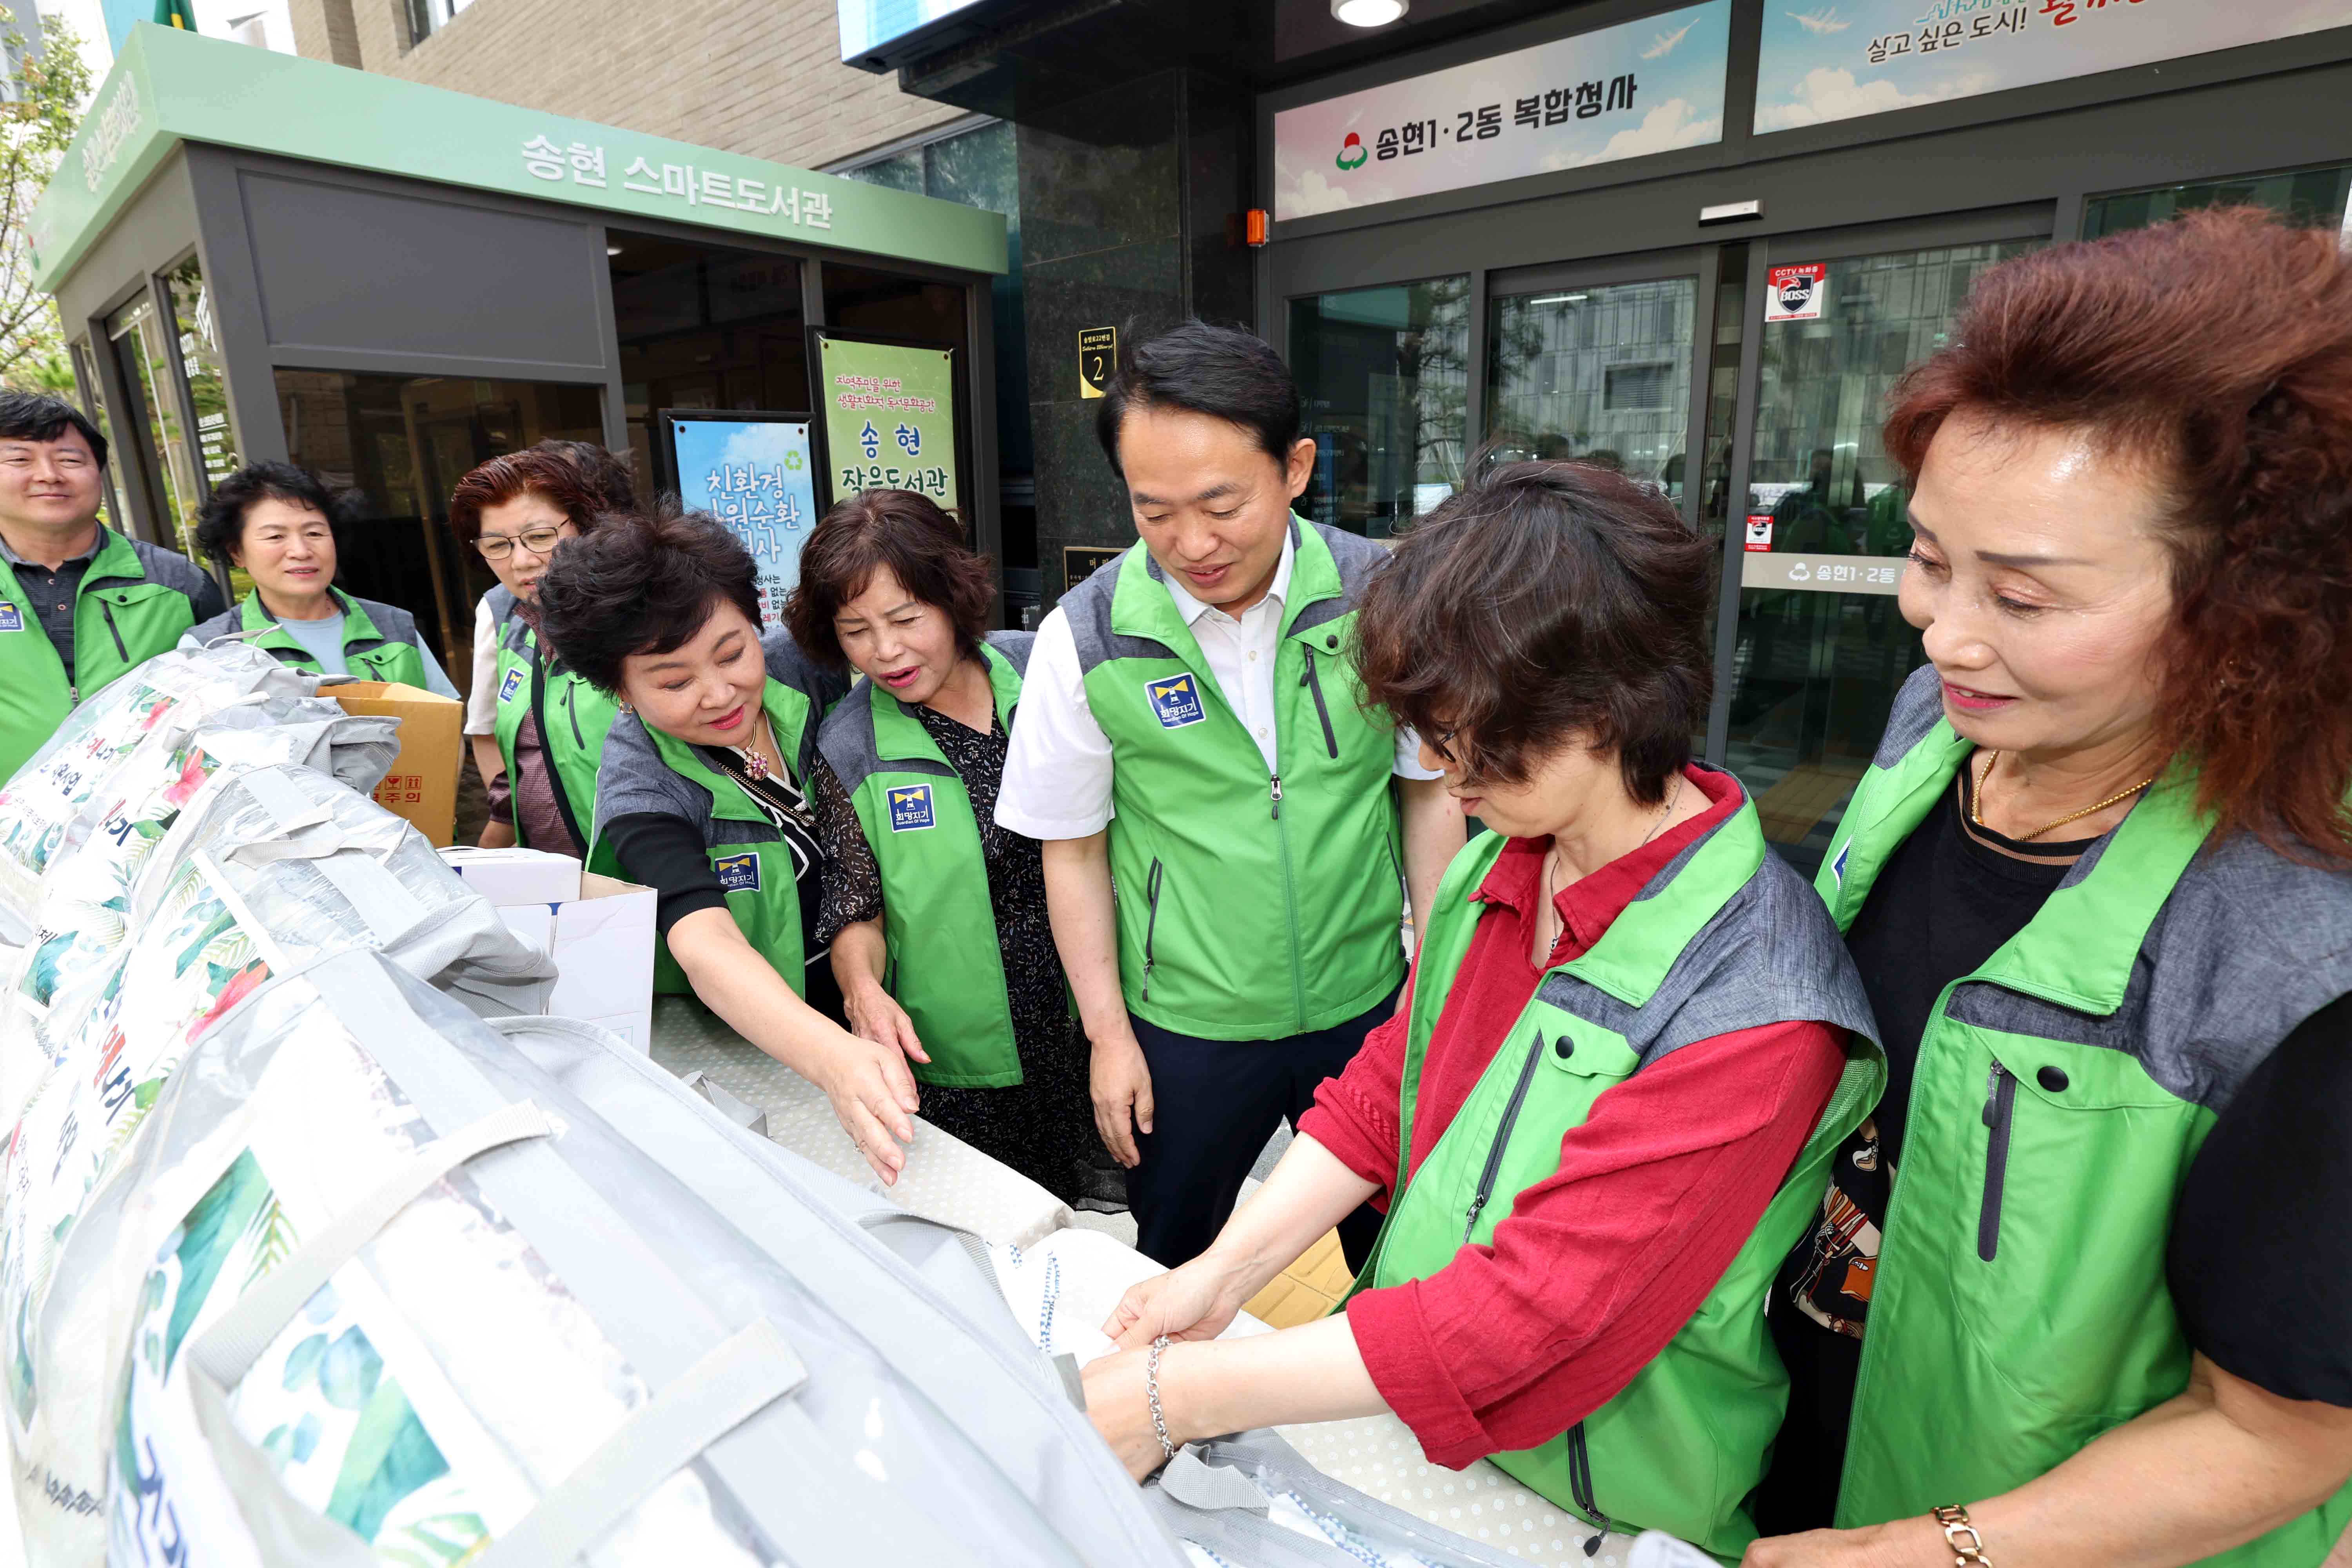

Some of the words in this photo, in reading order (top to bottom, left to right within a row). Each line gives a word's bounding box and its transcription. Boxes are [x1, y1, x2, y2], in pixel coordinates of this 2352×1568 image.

[1868, 34, 1911, 63] 살고
[1918, 25, 1963, 53] 싶은
[1969, 7, 2026, 39] 도시!
[1376, 103, 1502, 161] 송현1·2동
[1514, 73, 1637, 129] 복합청사
[522, 134, 607, 188] 송현
[624, 156, 832, 229] 스마트도서관
[1780, 289, 1810, 301] BOSS
[1093, 356, 1104, 381] 2
[836, 376, 879, 392] 지역주민을
[883, 379, 900, 392] 위한
[838, 394, 884, 409] 생활친화적
[887, 397, 935, 412] 독서문화공간
[706, 463, 784, 499] 친환경
[770, 587, 787, 597] 없는
[1160, 697, 1197, 718] 희망지기
[895, 805, 929, 820] 희망지기
[720, 871, 754, 884] 희망지기
